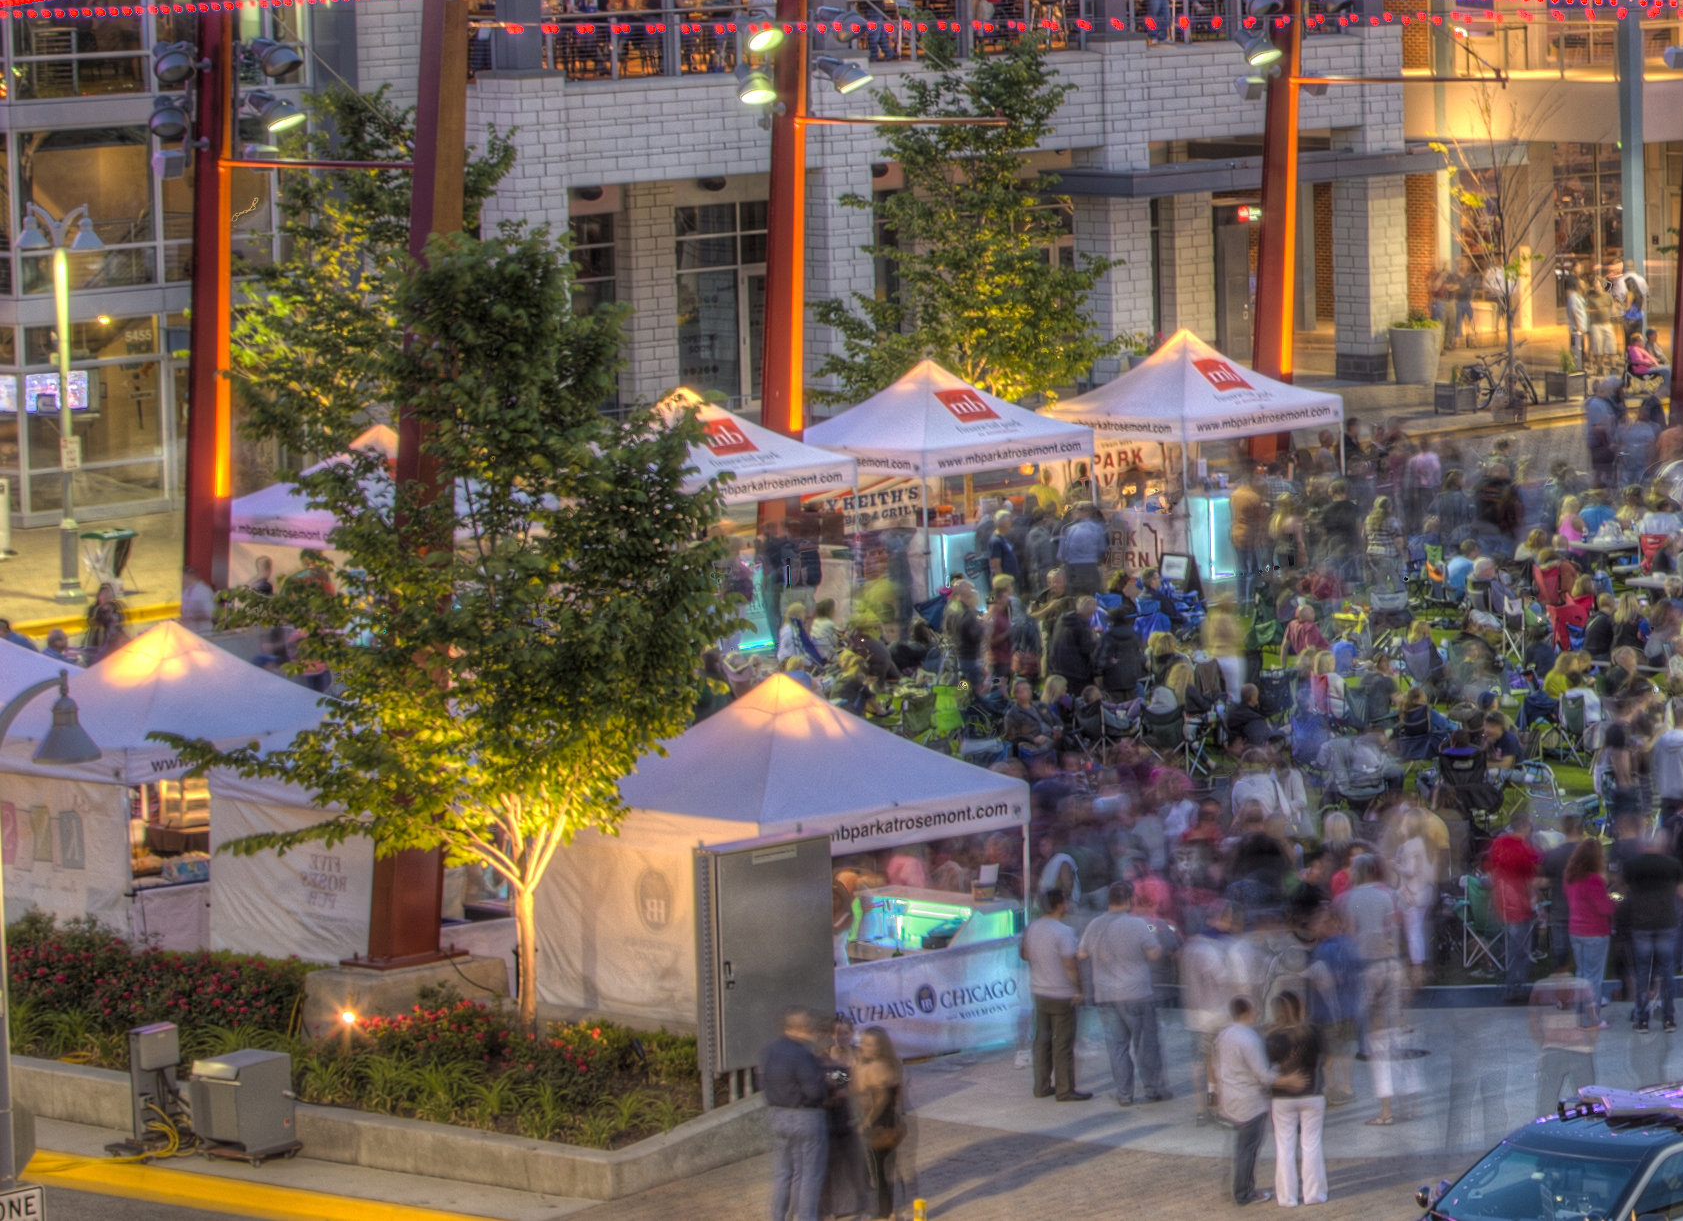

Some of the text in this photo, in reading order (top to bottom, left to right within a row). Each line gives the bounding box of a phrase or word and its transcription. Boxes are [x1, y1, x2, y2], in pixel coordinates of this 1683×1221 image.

[949, 394, 987, 416] mb
[1196, 406, 1331, 433] www.mbparkatrosemont.com
[937, 440, 1082, 469] www.mbparkatrosemont.com
[836, 999, 916, 1026] RÄUHAUS
[940, 977, 1018, 1007] CHICAGO
